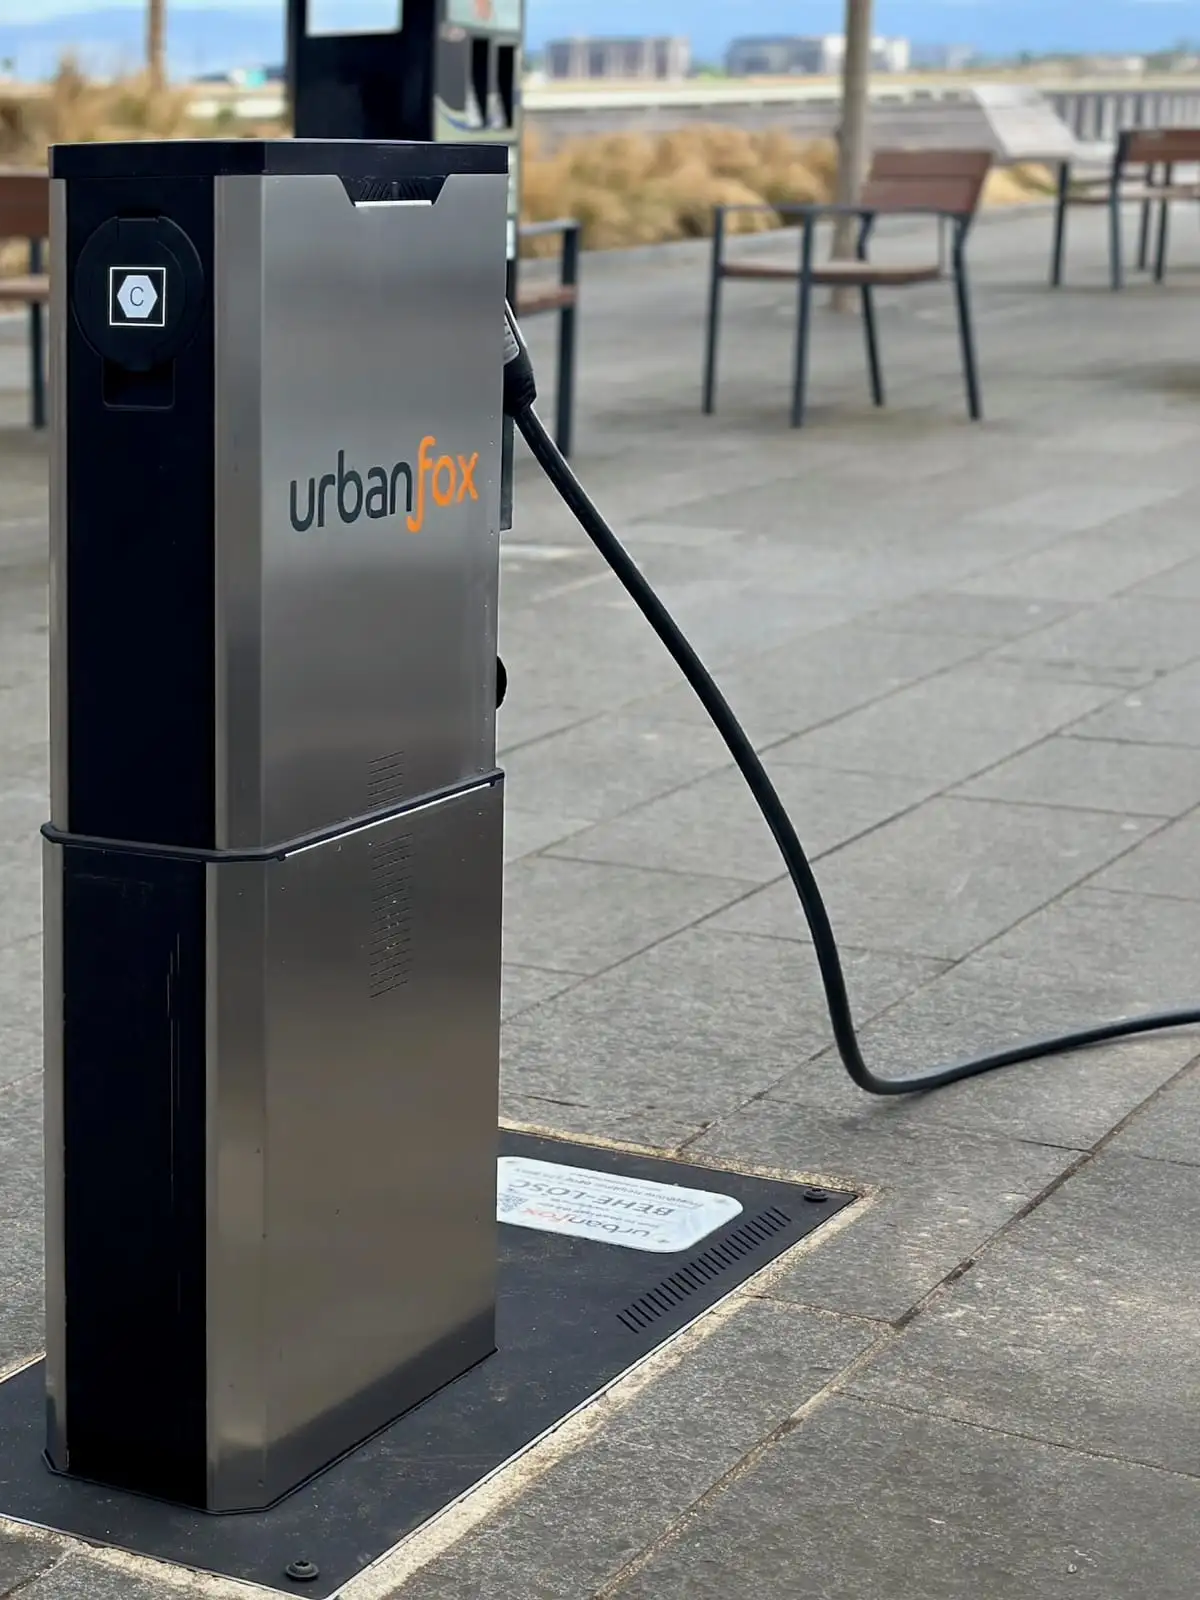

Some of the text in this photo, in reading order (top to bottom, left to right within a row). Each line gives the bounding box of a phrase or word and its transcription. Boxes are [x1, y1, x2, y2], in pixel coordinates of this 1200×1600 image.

[129, 286, 145, 307] C
[290, 435, 480, 533] urbanfox
[522, 1207, 650, 1237] urbanfox
